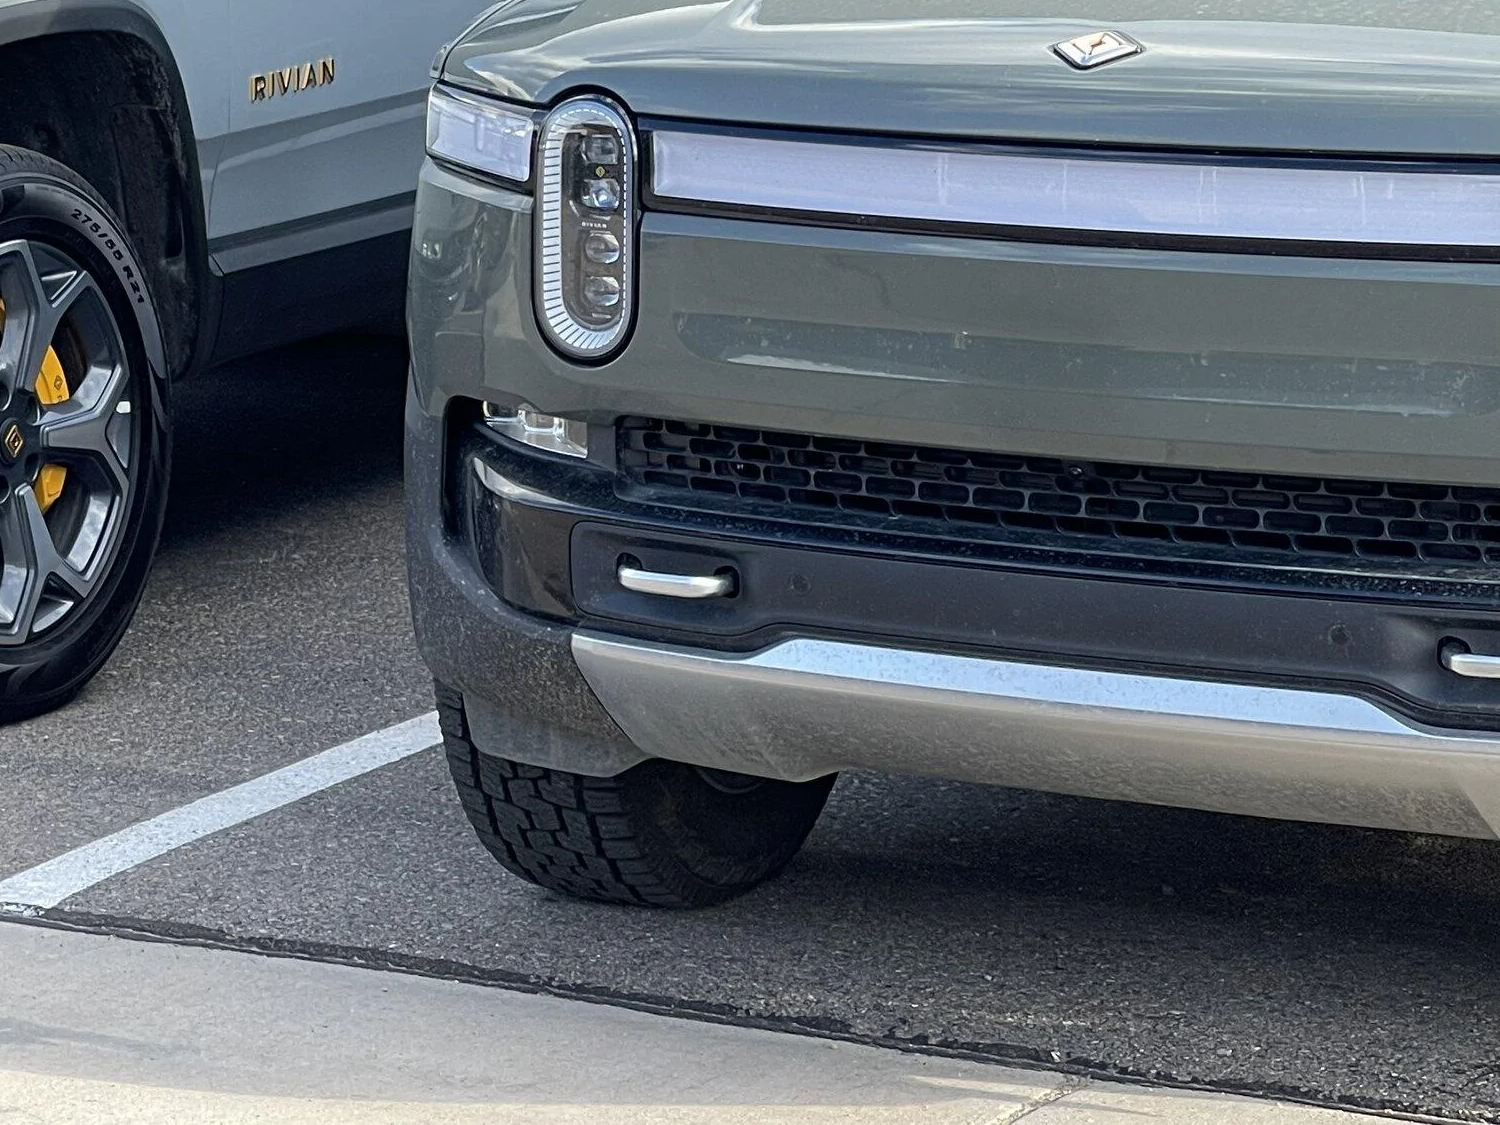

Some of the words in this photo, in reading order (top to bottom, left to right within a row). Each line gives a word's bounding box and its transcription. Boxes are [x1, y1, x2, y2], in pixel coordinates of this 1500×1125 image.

[248, 55, 335, 104] RIVIAN
[70, 208, 124, 261] 275/55
[122, 265, 145, 304] R21
